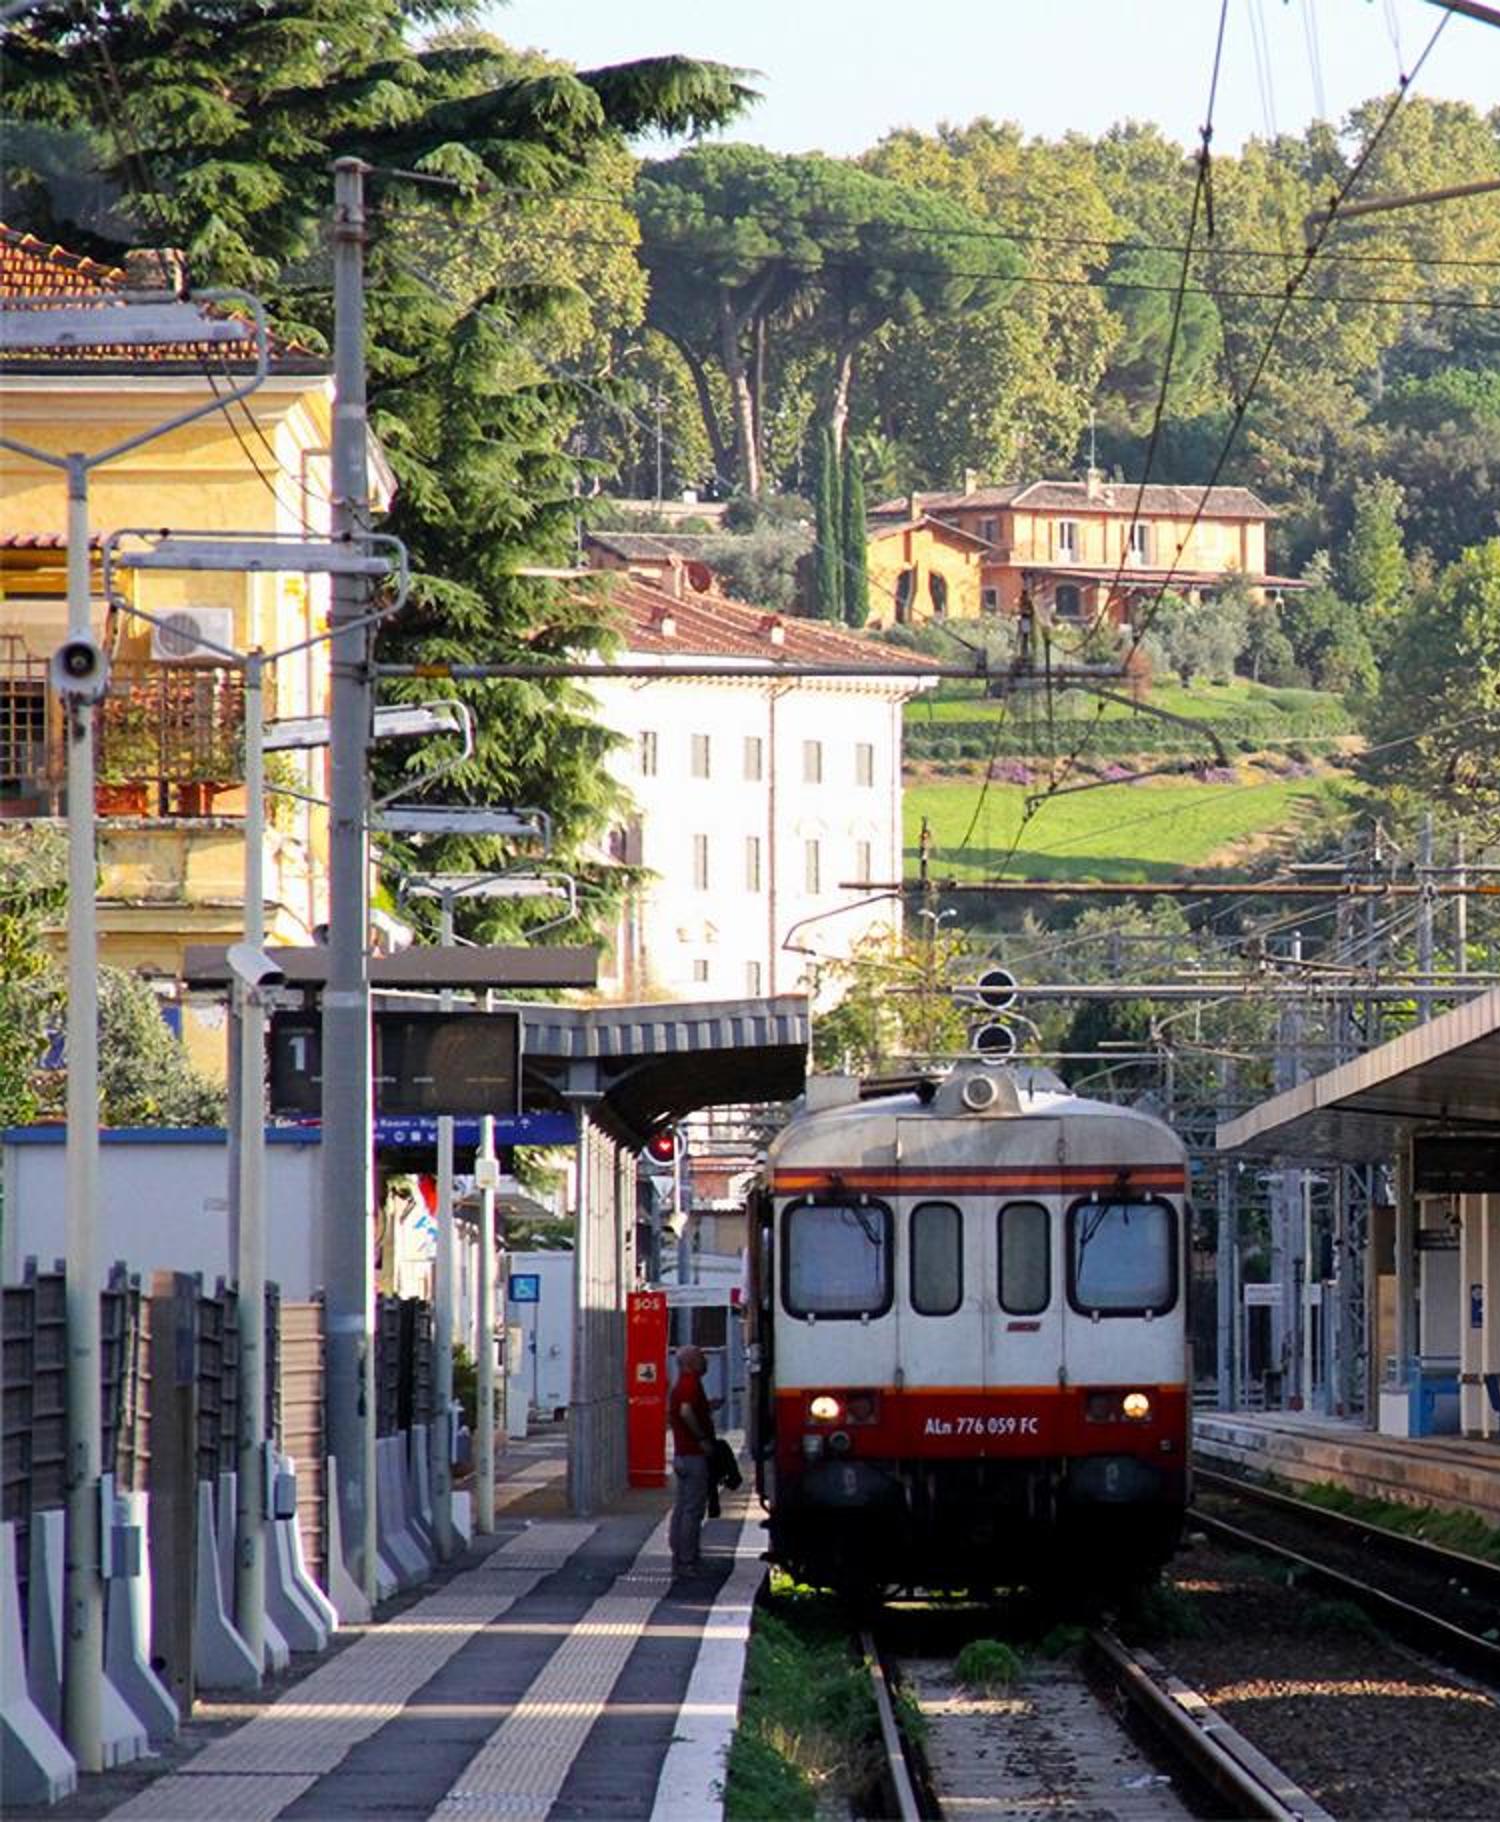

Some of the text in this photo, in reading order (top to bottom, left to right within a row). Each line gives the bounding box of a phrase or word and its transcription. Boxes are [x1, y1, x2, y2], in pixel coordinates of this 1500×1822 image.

[288, 1036, 305, 1070] 1
[633, 1297, 661, 1311] SOS
[925, 1416, 1039, 1435] ALn 776 059 FC
